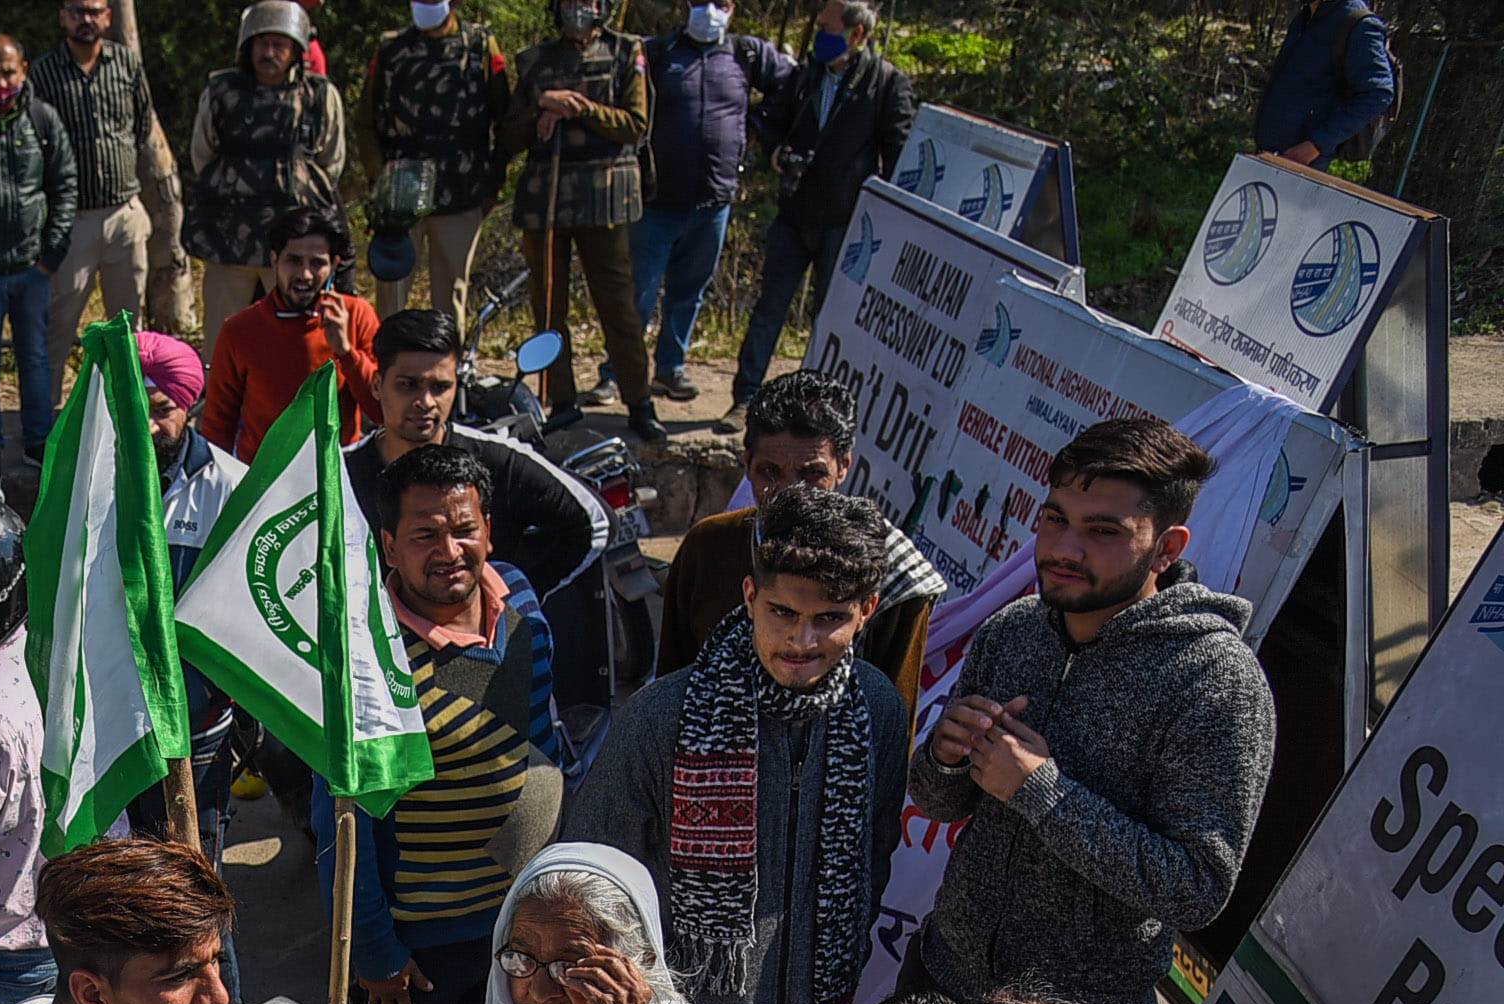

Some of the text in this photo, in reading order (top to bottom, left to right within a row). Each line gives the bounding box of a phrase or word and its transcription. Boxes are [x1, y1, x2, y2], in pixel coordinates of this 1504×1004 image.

[891, 240, 973, 320] HIMALAYAN
[854, 284, 967, 389] EXPRESSWAY LTD
[1011, 344, 1055, 389] NATIONAL
[1055, 367, 1112, 417] HIGHWAYS
[1025, 394, 1078, 437] HIMALAYAN
[957, 400, 1054, 487] VEHICLE WITHOU
[173, 519, 198, 532] BOSS
[950, 498, 989, 548] SHALL
